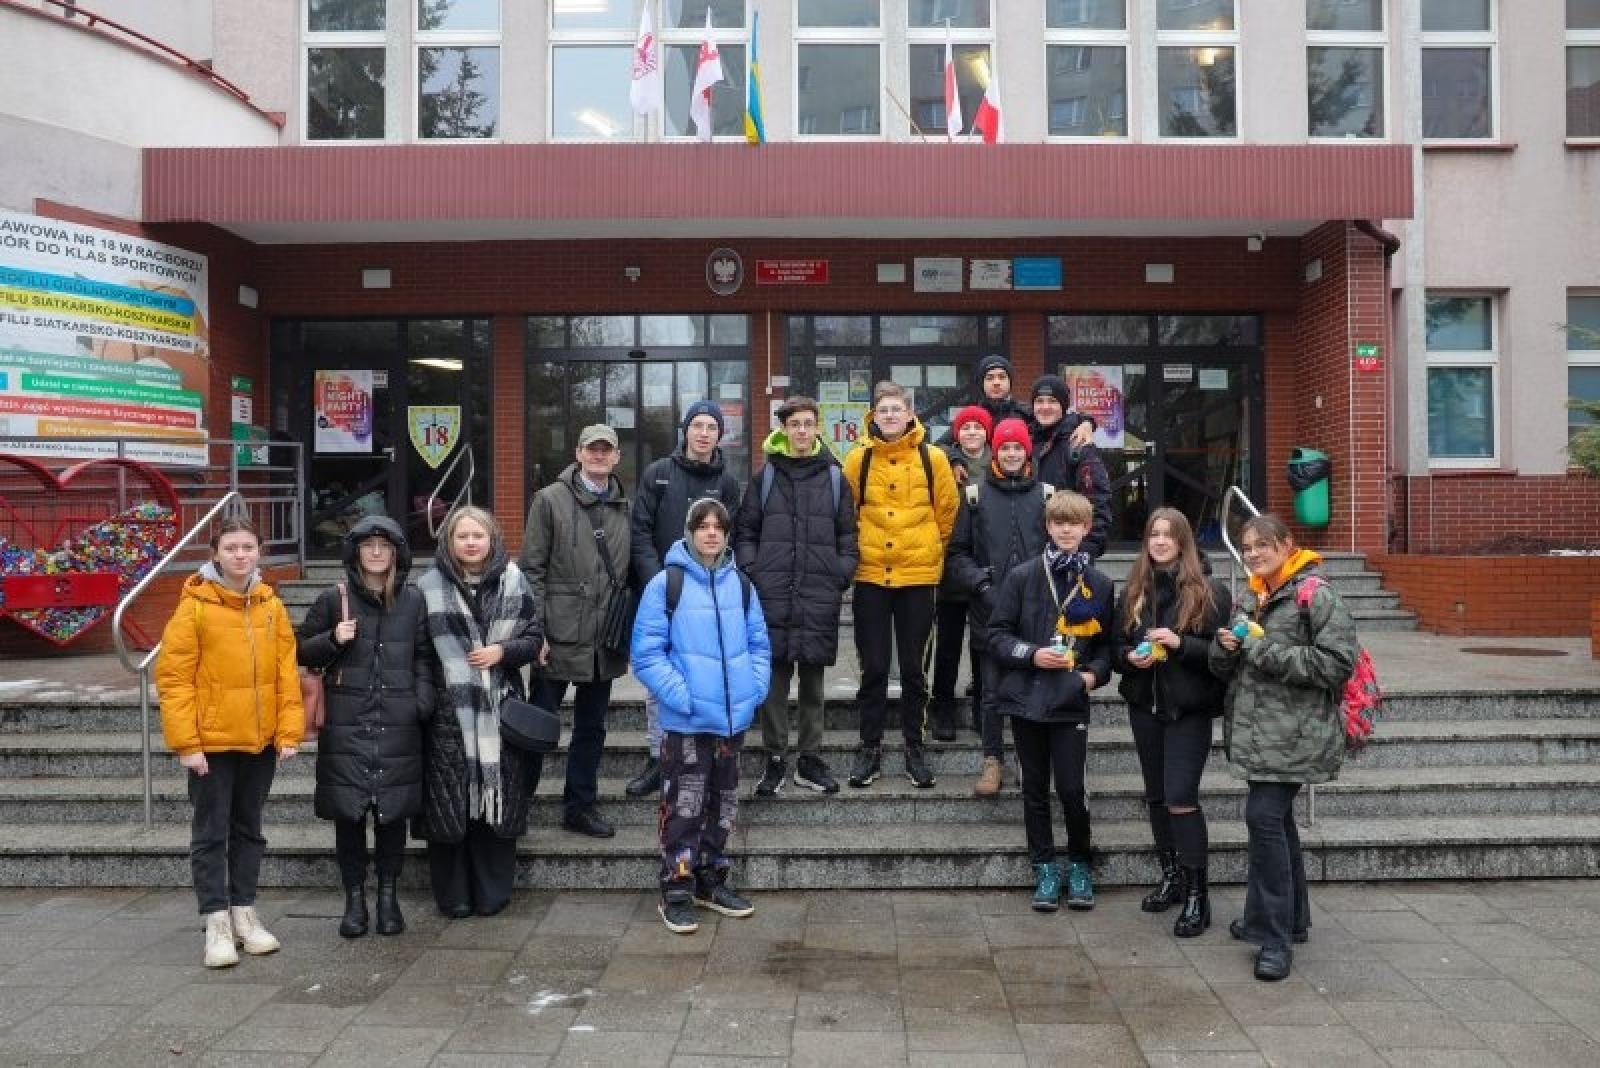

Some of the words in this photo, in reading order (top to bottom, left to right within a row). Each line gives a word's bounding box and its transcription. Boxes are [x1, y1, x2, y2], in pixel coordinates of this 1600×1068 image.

[0, 234, 30, 250] ÓR
[36, 241, 60, 255] DO
[66, 246, 107, 263] KLAS
[112, 256, 197, 284] SPORTOWYCH
[74, 233, 95, 247] NR
[101, 239, 115, 250] 18
[119, 243, 133, 254] W
[136, 245, 203, 273] RACIBORZU
[424, 426, 449, 446] 18
[833, 423, 857, 442] 18
